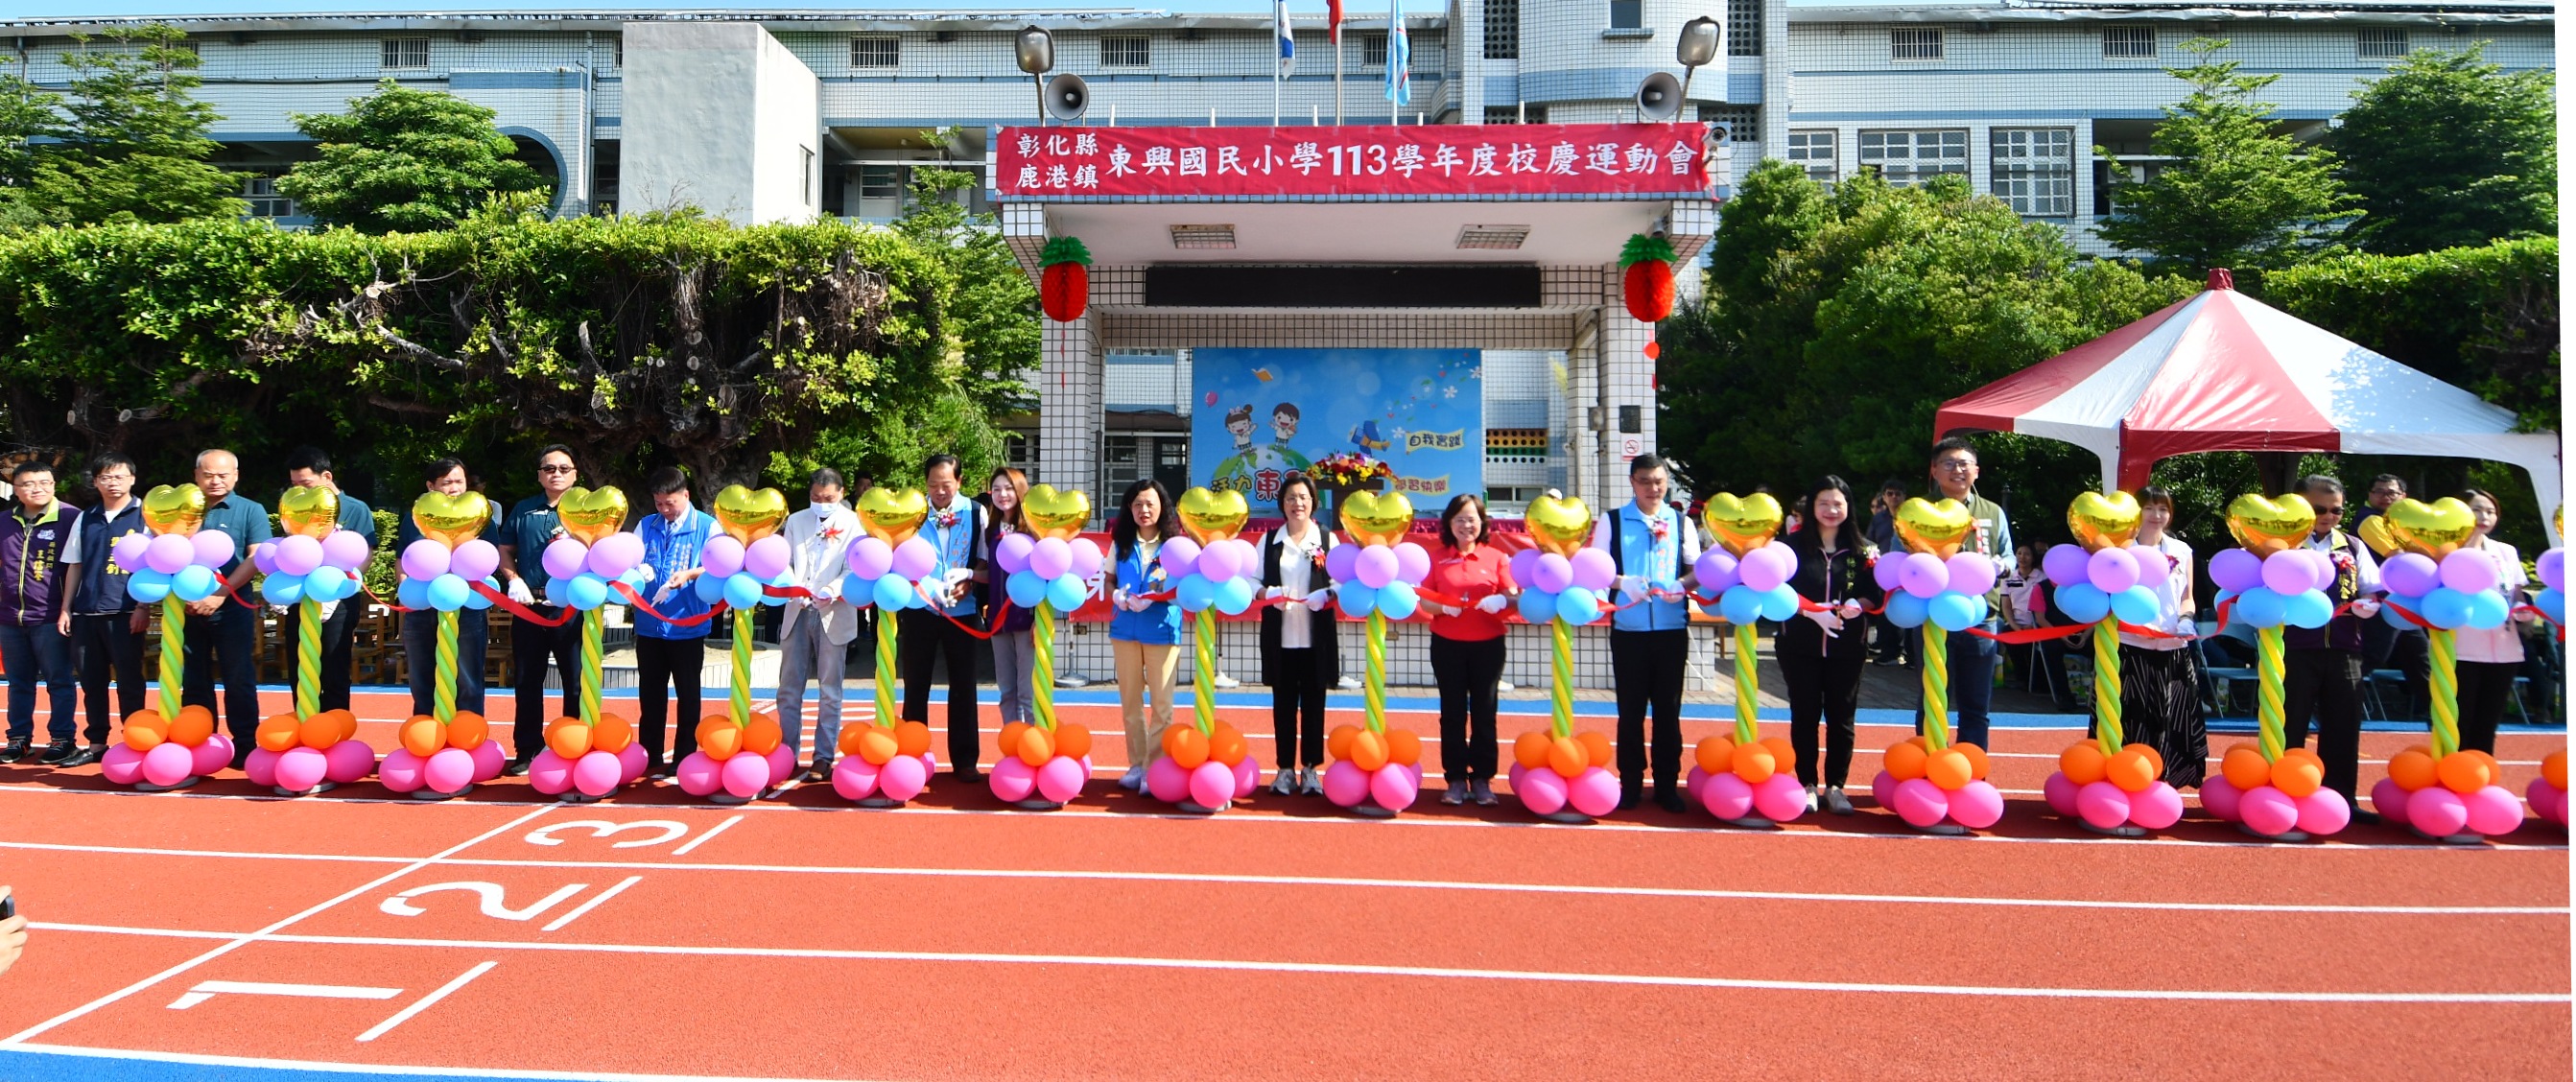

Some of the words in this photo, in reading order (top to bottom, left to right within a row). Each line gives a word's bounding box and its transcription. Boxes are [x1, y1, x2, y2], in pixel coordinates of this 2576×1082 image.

[1017, 133, 1099, 158] 彰化縣
[1105, 140, 1698, 178] 東興國民小學113學年度校慶運動會
[1015, 163, 1099, 189] 鹿港鎮
[1210, 467, 1302, 502] 活力東
[524, 819, 689, 849] 3
[379, 881, 589, 921] 2
[166, 979, 403, 1010] 1
